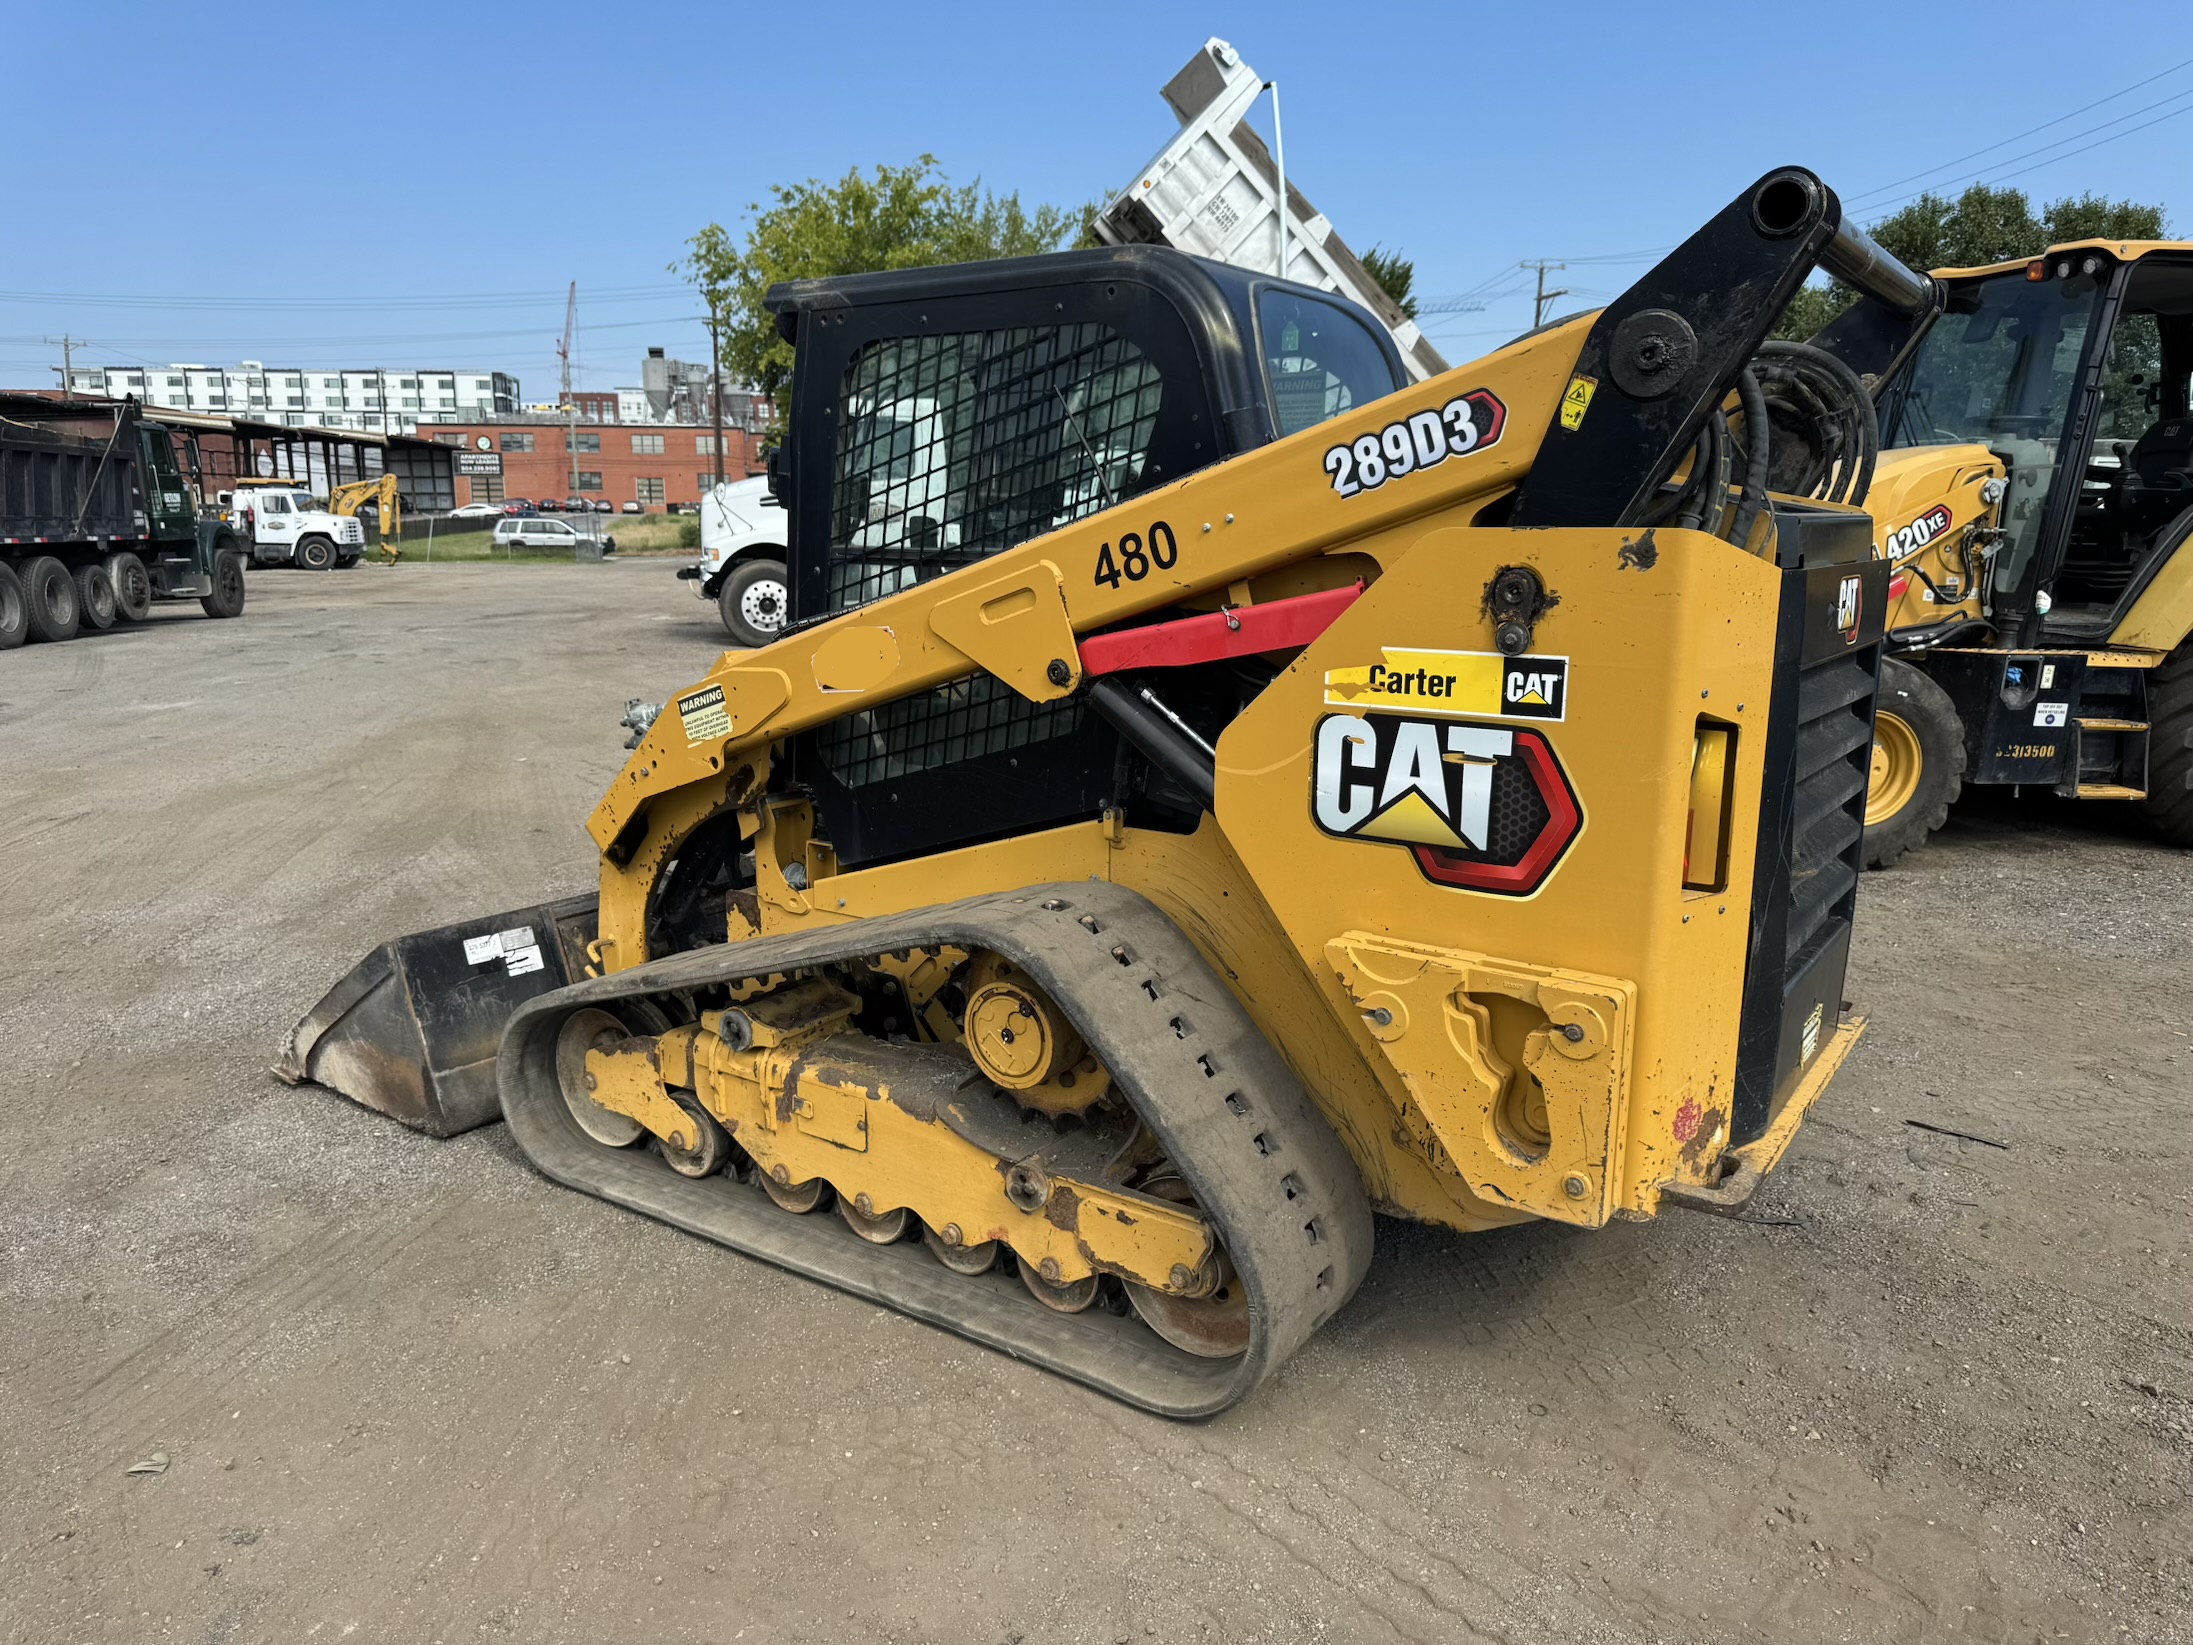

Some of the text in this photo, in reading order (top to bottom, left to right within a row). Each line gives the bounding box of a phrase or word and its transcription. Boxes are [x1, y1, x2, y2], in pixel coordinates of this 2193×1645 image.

[1273, 379, 1322, 392] ARNING
[1325, 400, 1478, 496] 289D3
[2163, 425, 2181, 437] CAT
[1094, 520, 1178, 589] 480
[1837, 578, 1859, 630] CAT
[680, 690, 723, 713] WARNING
[1369, 664, 1457, 698] Carter
[1316, 715, 1513, 851] CAT
